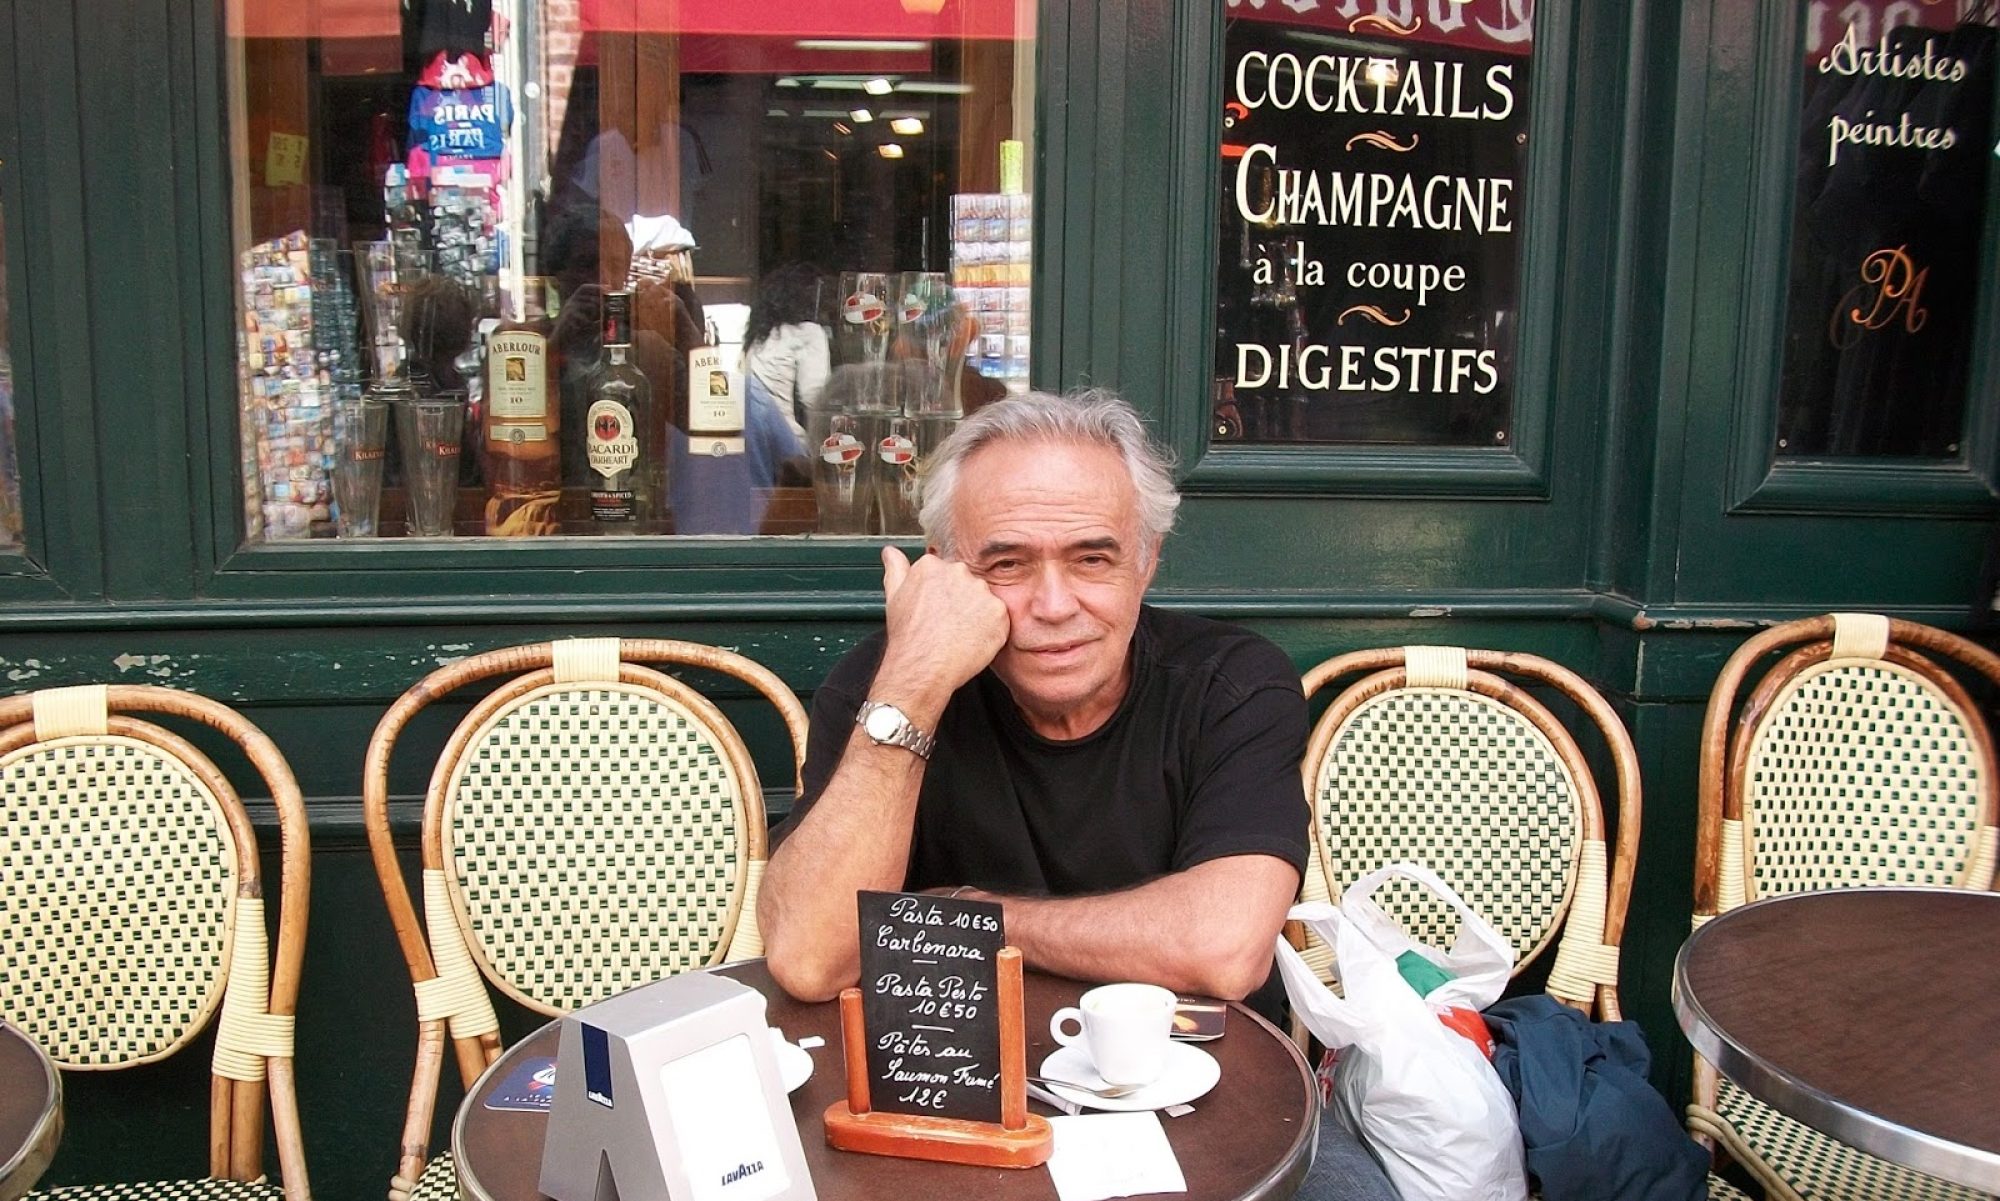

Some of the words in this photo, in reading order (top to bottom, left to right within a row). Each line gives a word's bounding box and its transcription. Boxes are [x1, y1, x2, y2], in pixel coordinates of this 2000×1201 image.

[1819, 21, 1968, 82] Artistes
[1235, 51, 1514, 121] COCKTAILS
[1827, 110, 1957, 167] peintres
[1235, 143, 1512, 235] CHAMPAGNE
[1253, 244, 1274, 286] à
[1295, 241, 1325, 286] la
[1347, 260, 1466, 306] coupe
[1234, 343, 1498, 394] DIGESTIFS
[889, 897, 945, 926] Pasta
[876, 924, 986, 961] Carbonara
[875, 973, 935, 998] Pasta
[938, 975, 989, 1001] Pesto
[877, 1031, 932, 1057] Pâtes
[934, 1046, 973, 1058] au
[881, 1058, 950, 1085] Saumon
[952, 1063, 1001, 1090] Fumé
[898, 1085, 948, 1109] 12€
[721, 1160, 765, 1187] LAVAZZA
